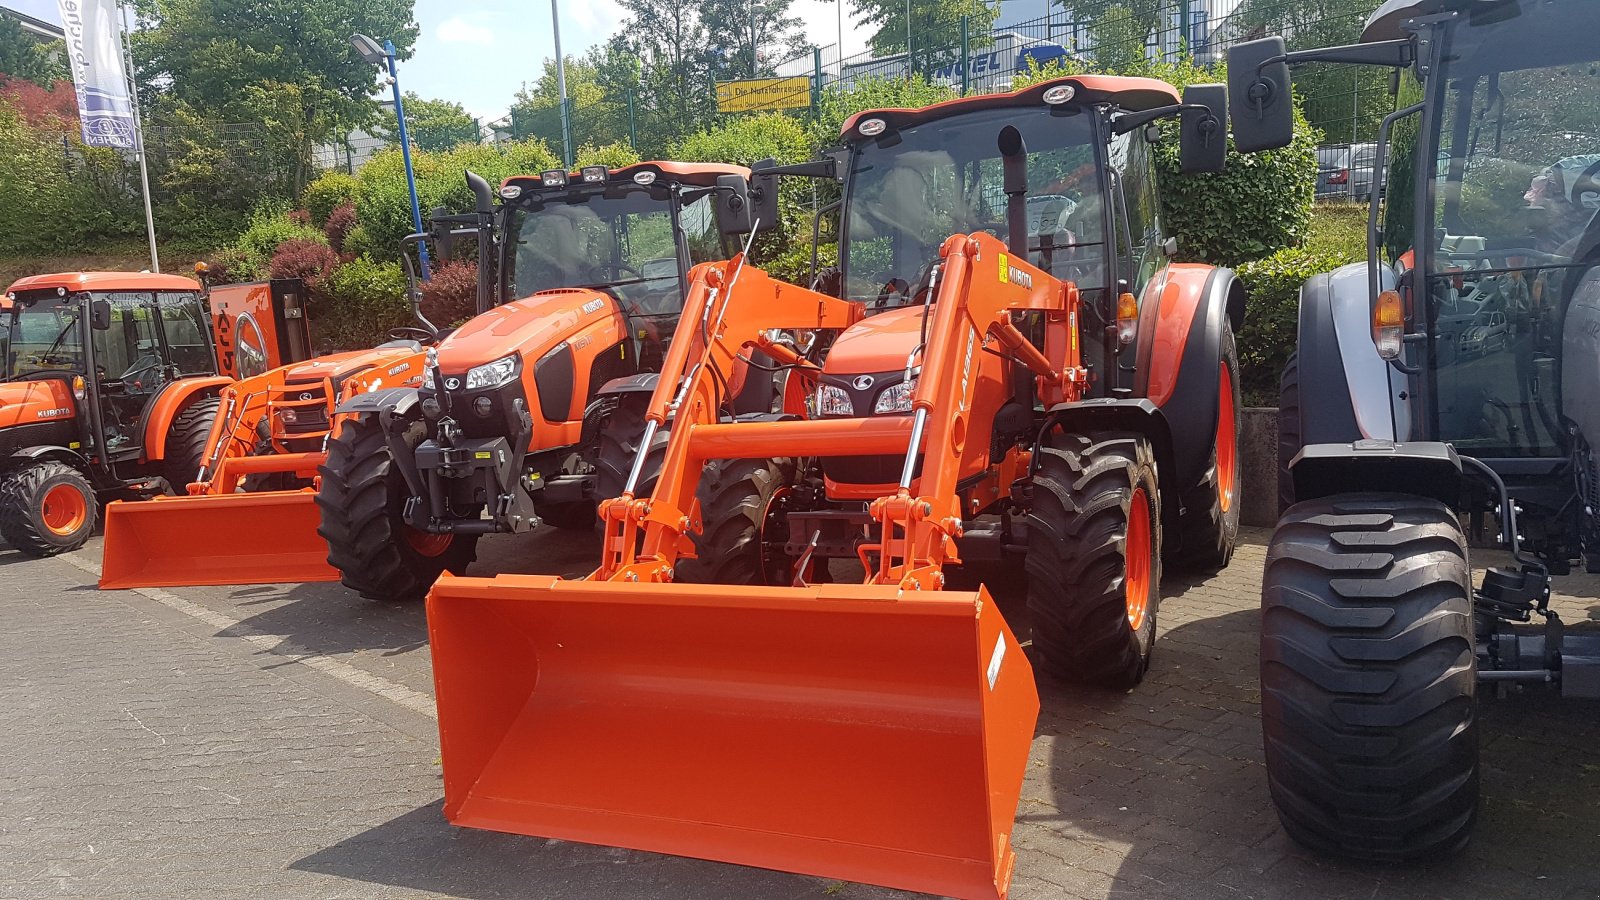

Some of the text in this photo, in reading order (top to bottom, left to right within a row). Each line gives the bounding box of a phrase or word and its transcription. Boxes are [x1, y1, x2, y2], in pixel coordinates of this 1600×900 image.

[735, 87, 748, 96] Die
[1009, 265, 1032, 290] KUBOTA
[37, 408, 70, 418] KUBOTA
